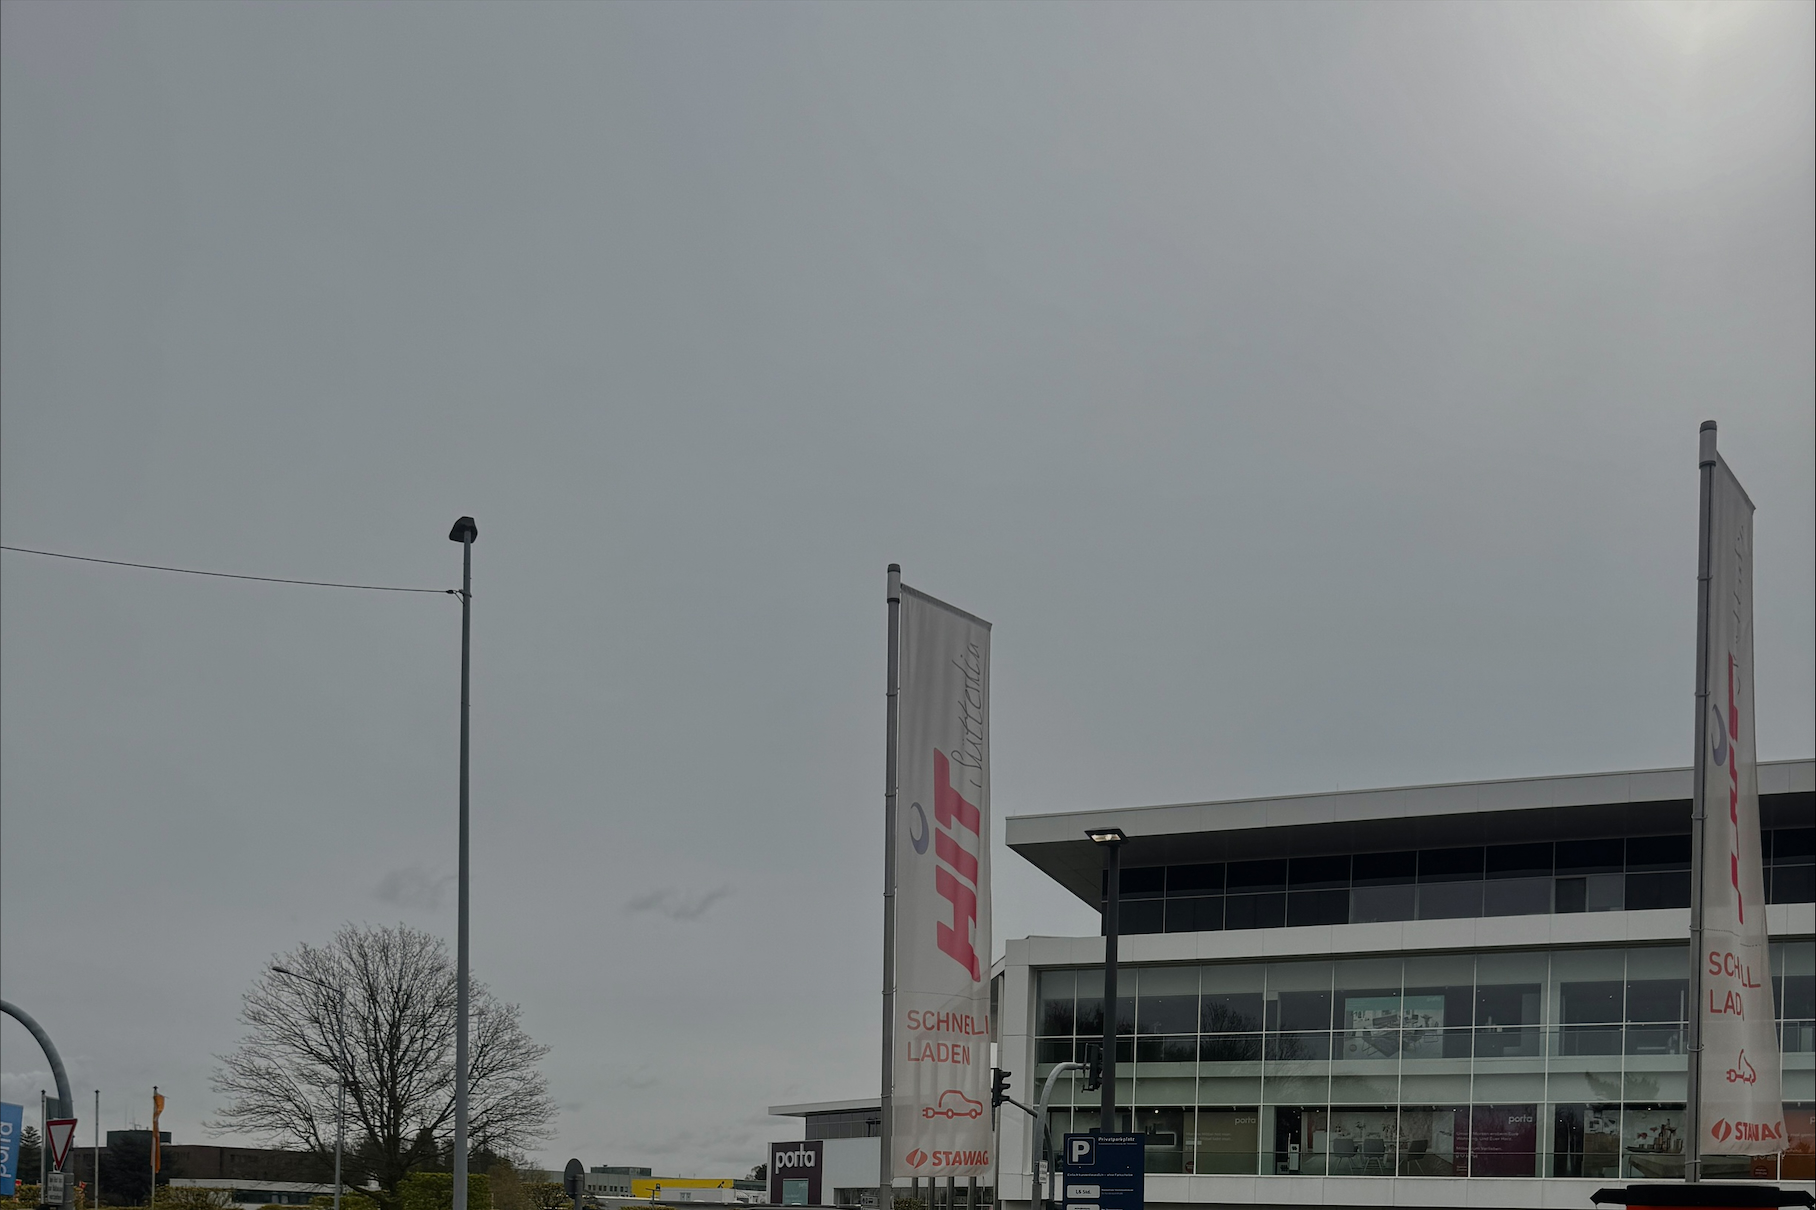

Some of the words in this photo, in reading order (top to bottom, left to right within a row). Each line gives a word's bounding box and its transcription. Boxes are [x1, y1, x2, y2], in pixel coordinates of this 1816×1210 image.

[933, 747, 981, 983] HIT
[907, 1041, 971, 1065] LADEN
[1234, 1116, 1257, 1125] porta
[1508, 1114, 1533, 1124] porta
[775, 1143, 816, 1175] porta
[932, 1150, 989, 1167] STAWAG
[1072, 1140, 1091, 1163] P
